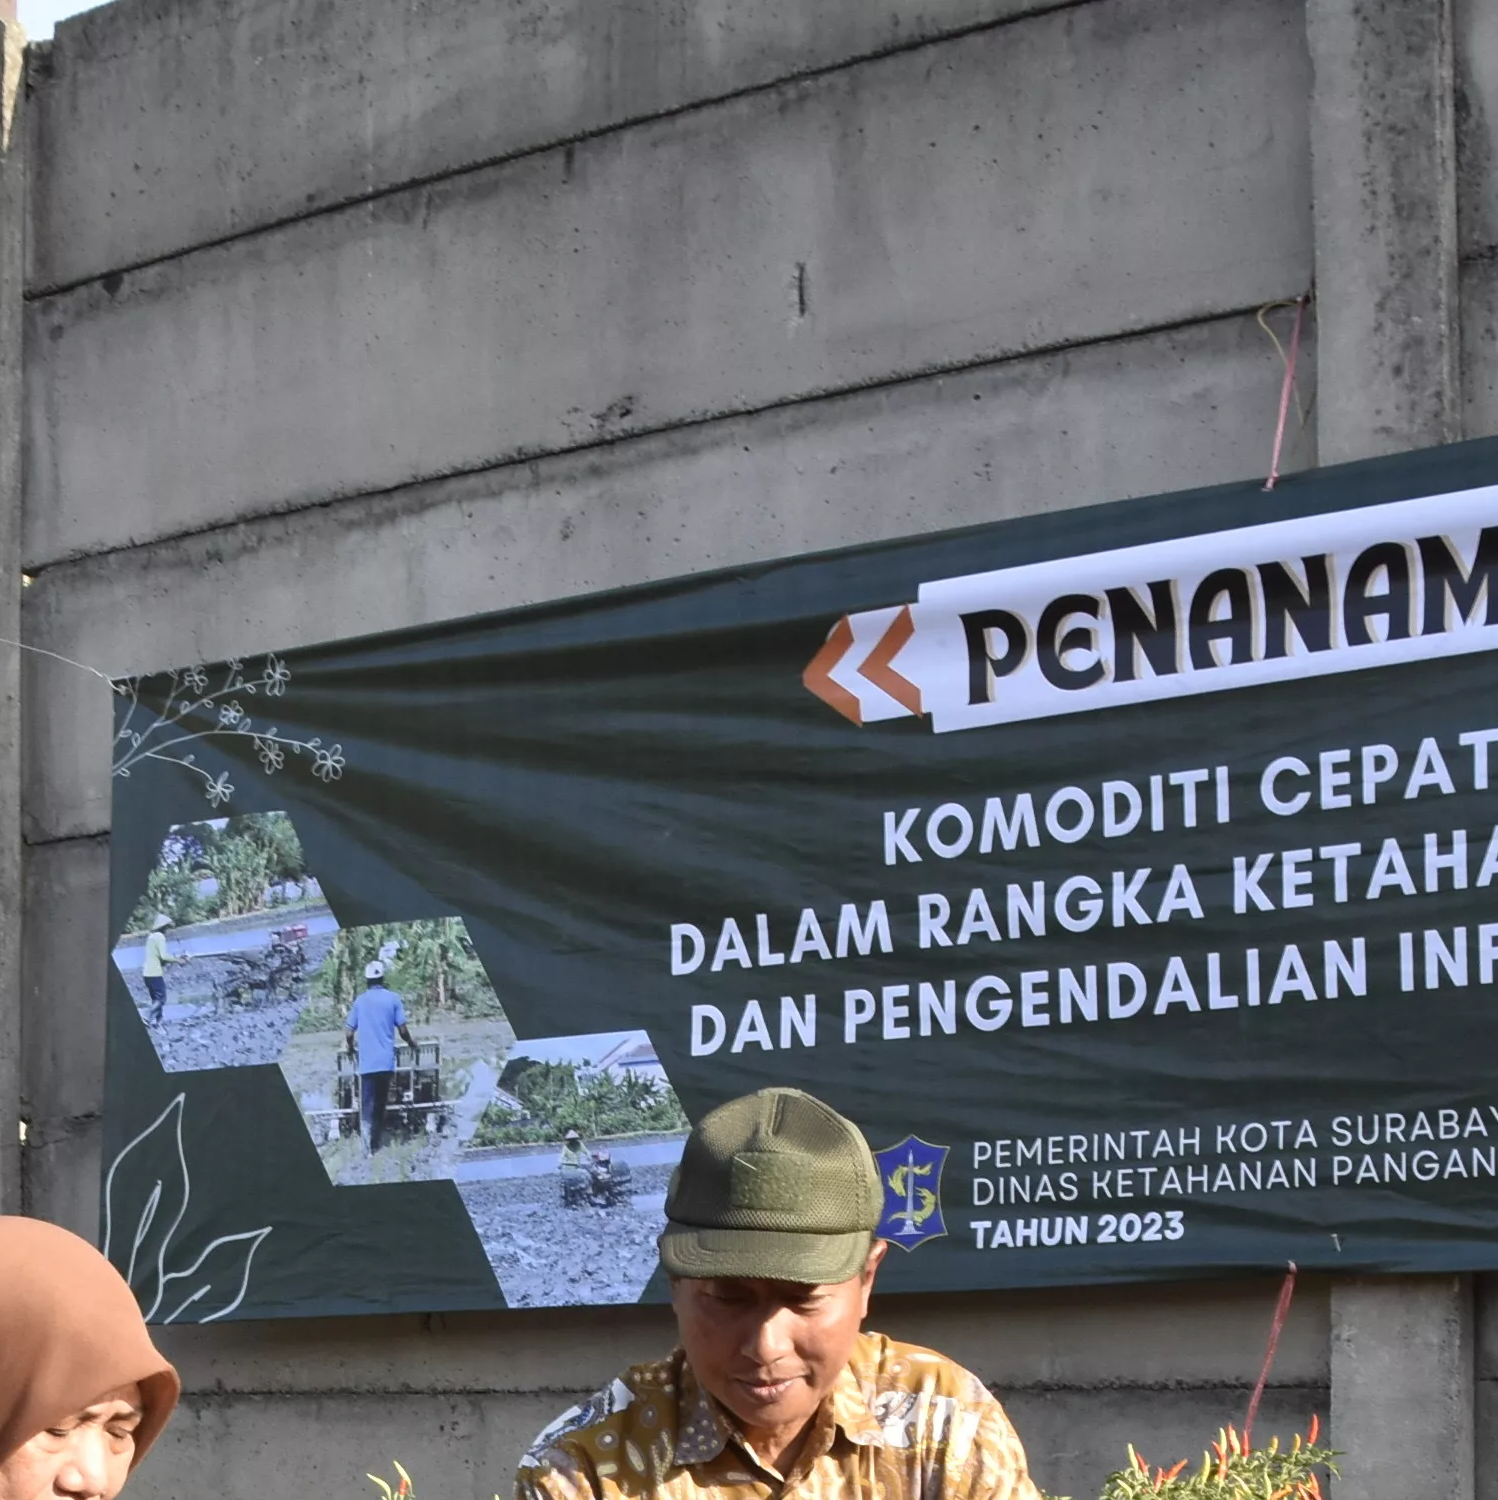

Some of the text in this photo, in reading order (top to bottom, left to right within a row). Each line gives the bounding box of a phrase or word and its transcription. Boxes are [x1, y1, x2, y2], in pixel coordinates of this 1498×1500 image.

[884, 766, 1229, 865] KOMODITI
[671, 900, 893, 975] DALAM
[918, 864, 1204, 948] RANGKA
[691, 994, 816, 1056] DAN
[843, 937, 1366, 1043] PENGENDALIAN
[974, 1127, 1199, 1169] PEMERINTAH
[1217, 1120, 1317, 1153] KOTA
[974, 1173, 1078, 1205] DINAS
[1093, 1158, 1315, 1198] KETAHANAN
[1333, 1147, 1495, 1185] PANGAN
[970, 1211, 1184, 1248] TAHUN 2023
